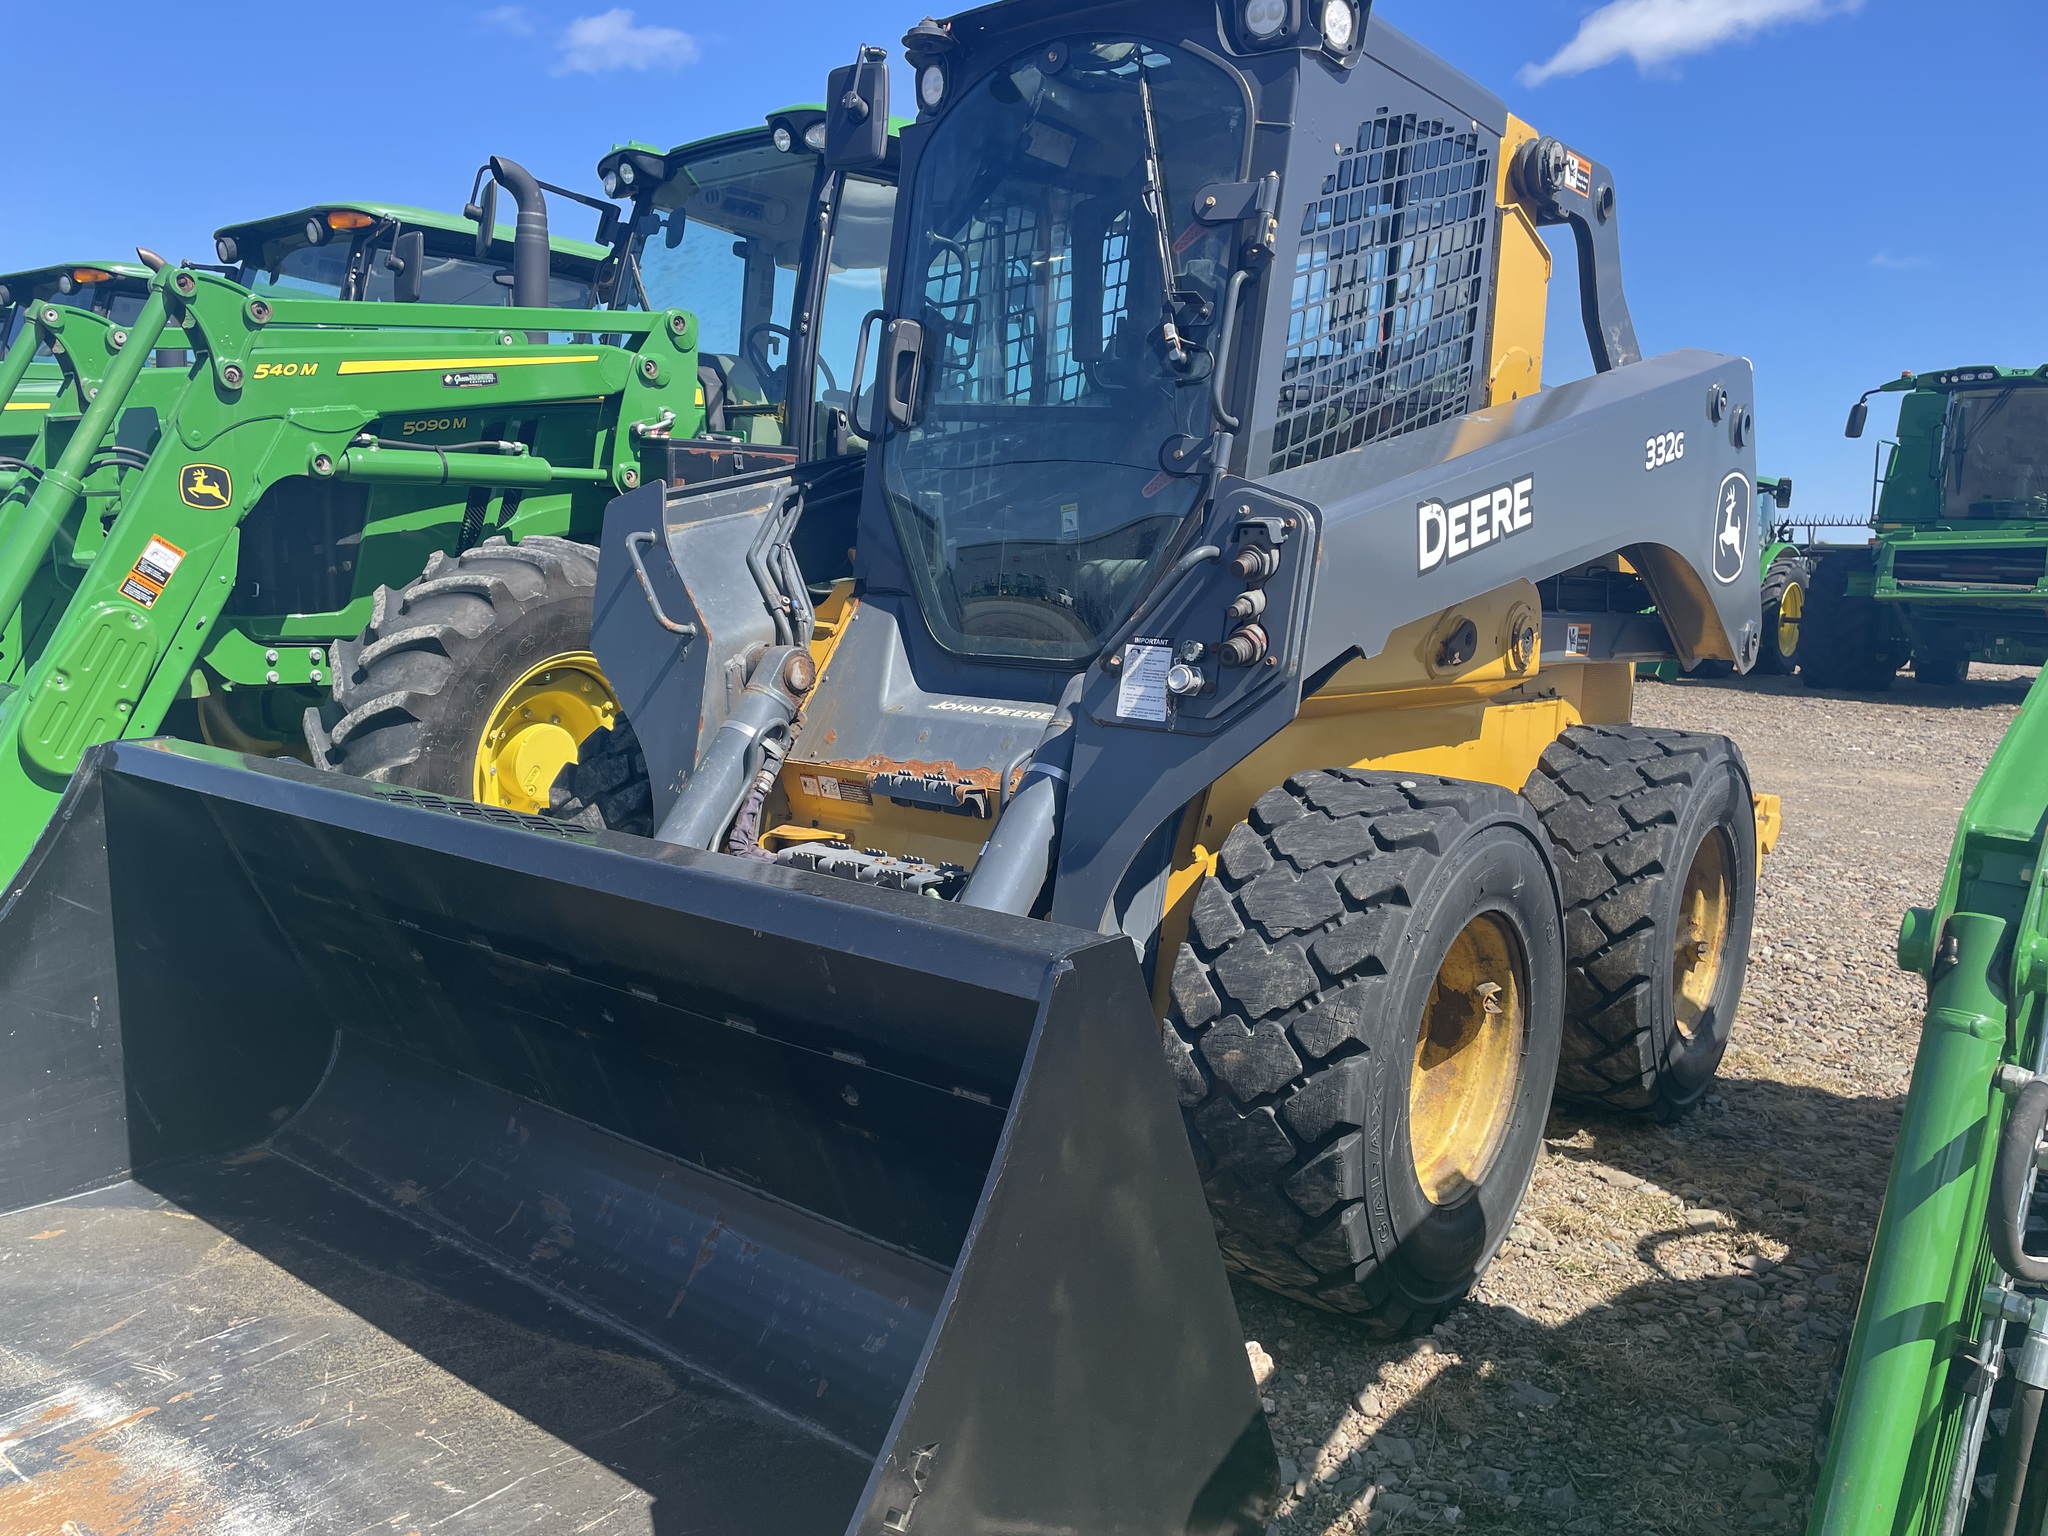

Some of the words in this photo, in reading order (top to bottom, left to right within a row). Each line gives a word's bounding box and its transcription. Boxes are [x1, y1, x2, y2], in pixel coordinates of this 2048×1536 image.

[1645, 430, 1685, 471] 332G
[1418, 477, 1533, 571] DEERE
[1134, 637, 1169, 646] IMPORTANT
[927, 701, 984, 713] JOHN
[983, 706, 1055, 719] DEERE
